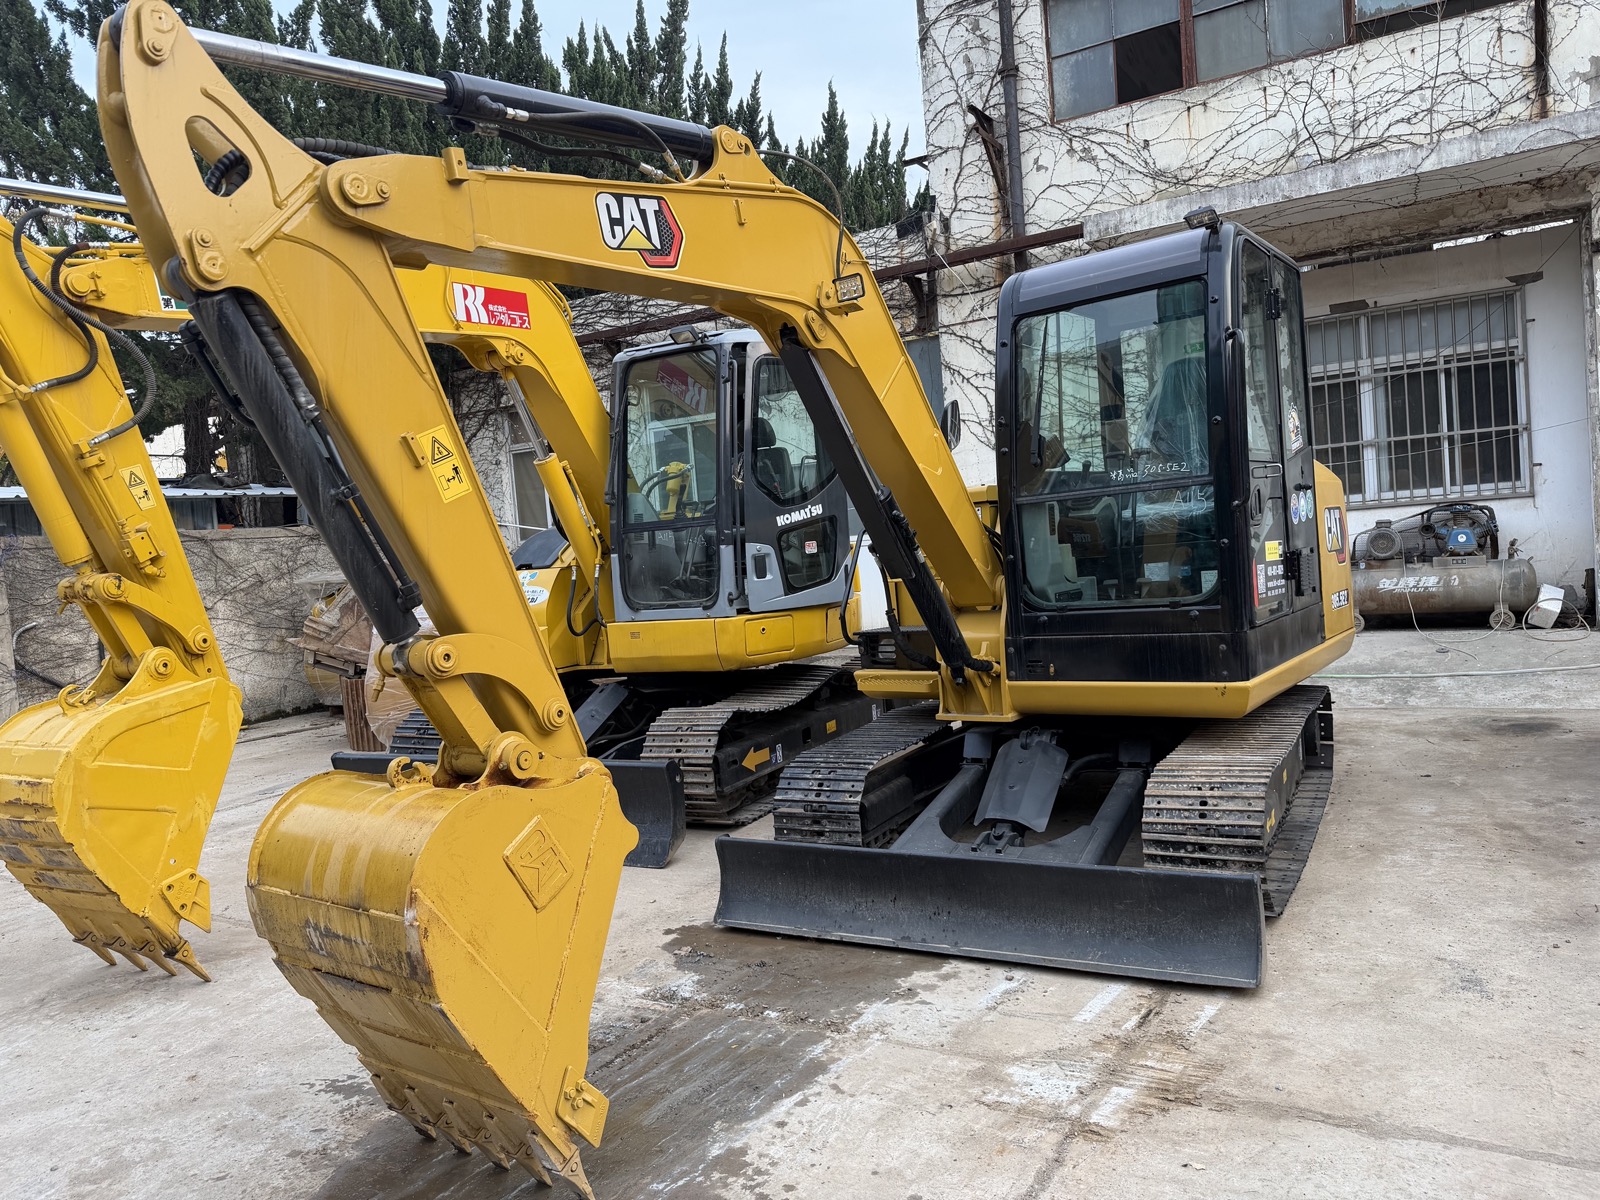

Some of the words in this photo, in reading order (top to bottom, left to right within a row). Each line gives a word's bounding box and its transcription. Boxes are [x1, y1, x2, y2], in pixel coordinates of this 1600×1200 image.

[596, 192, 662, 250] CAT
[776, 504, 823, 527] KOMATSU
[1324, 508, 1342, 552] CAT
